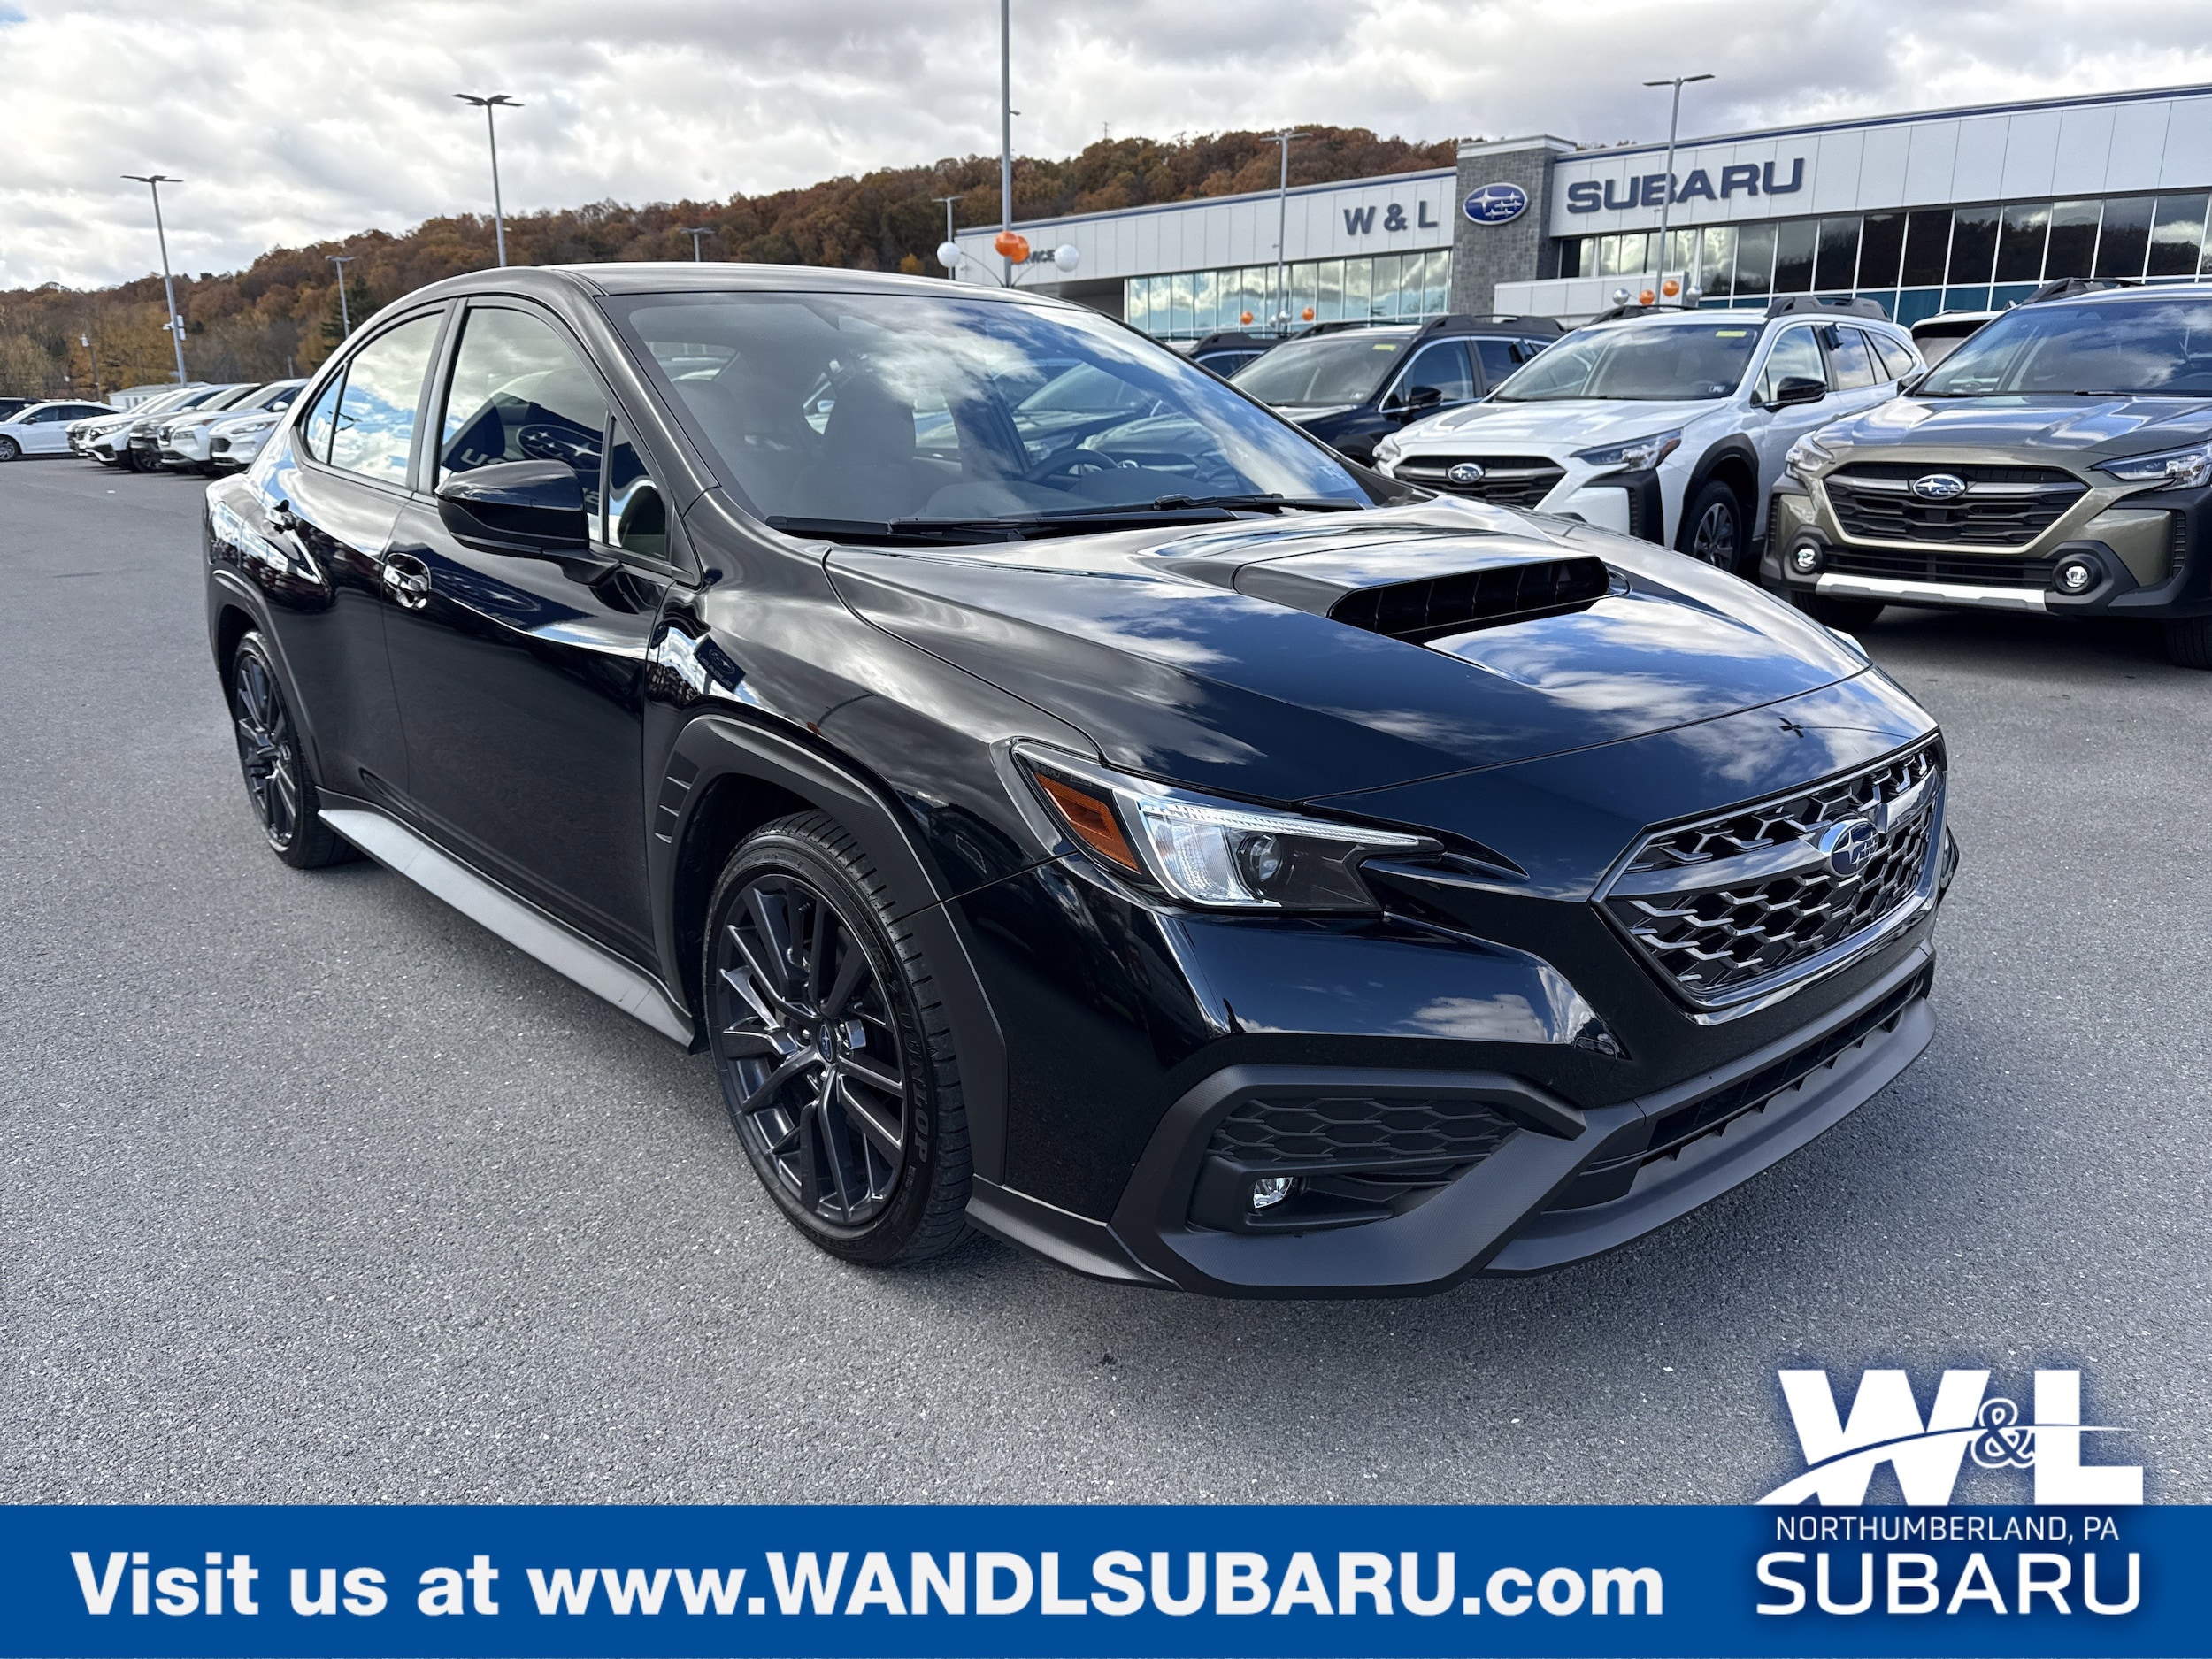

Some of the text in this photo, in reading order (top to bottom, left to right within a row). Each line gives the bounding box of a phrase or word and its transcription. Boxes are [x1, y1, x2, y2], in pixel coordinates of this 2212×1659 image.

[1567, 157, 1805, 214] SUBARU
[1343, 200, 1440, 236] W & L
[895, 1005, 929, 1163] DUNLOP
